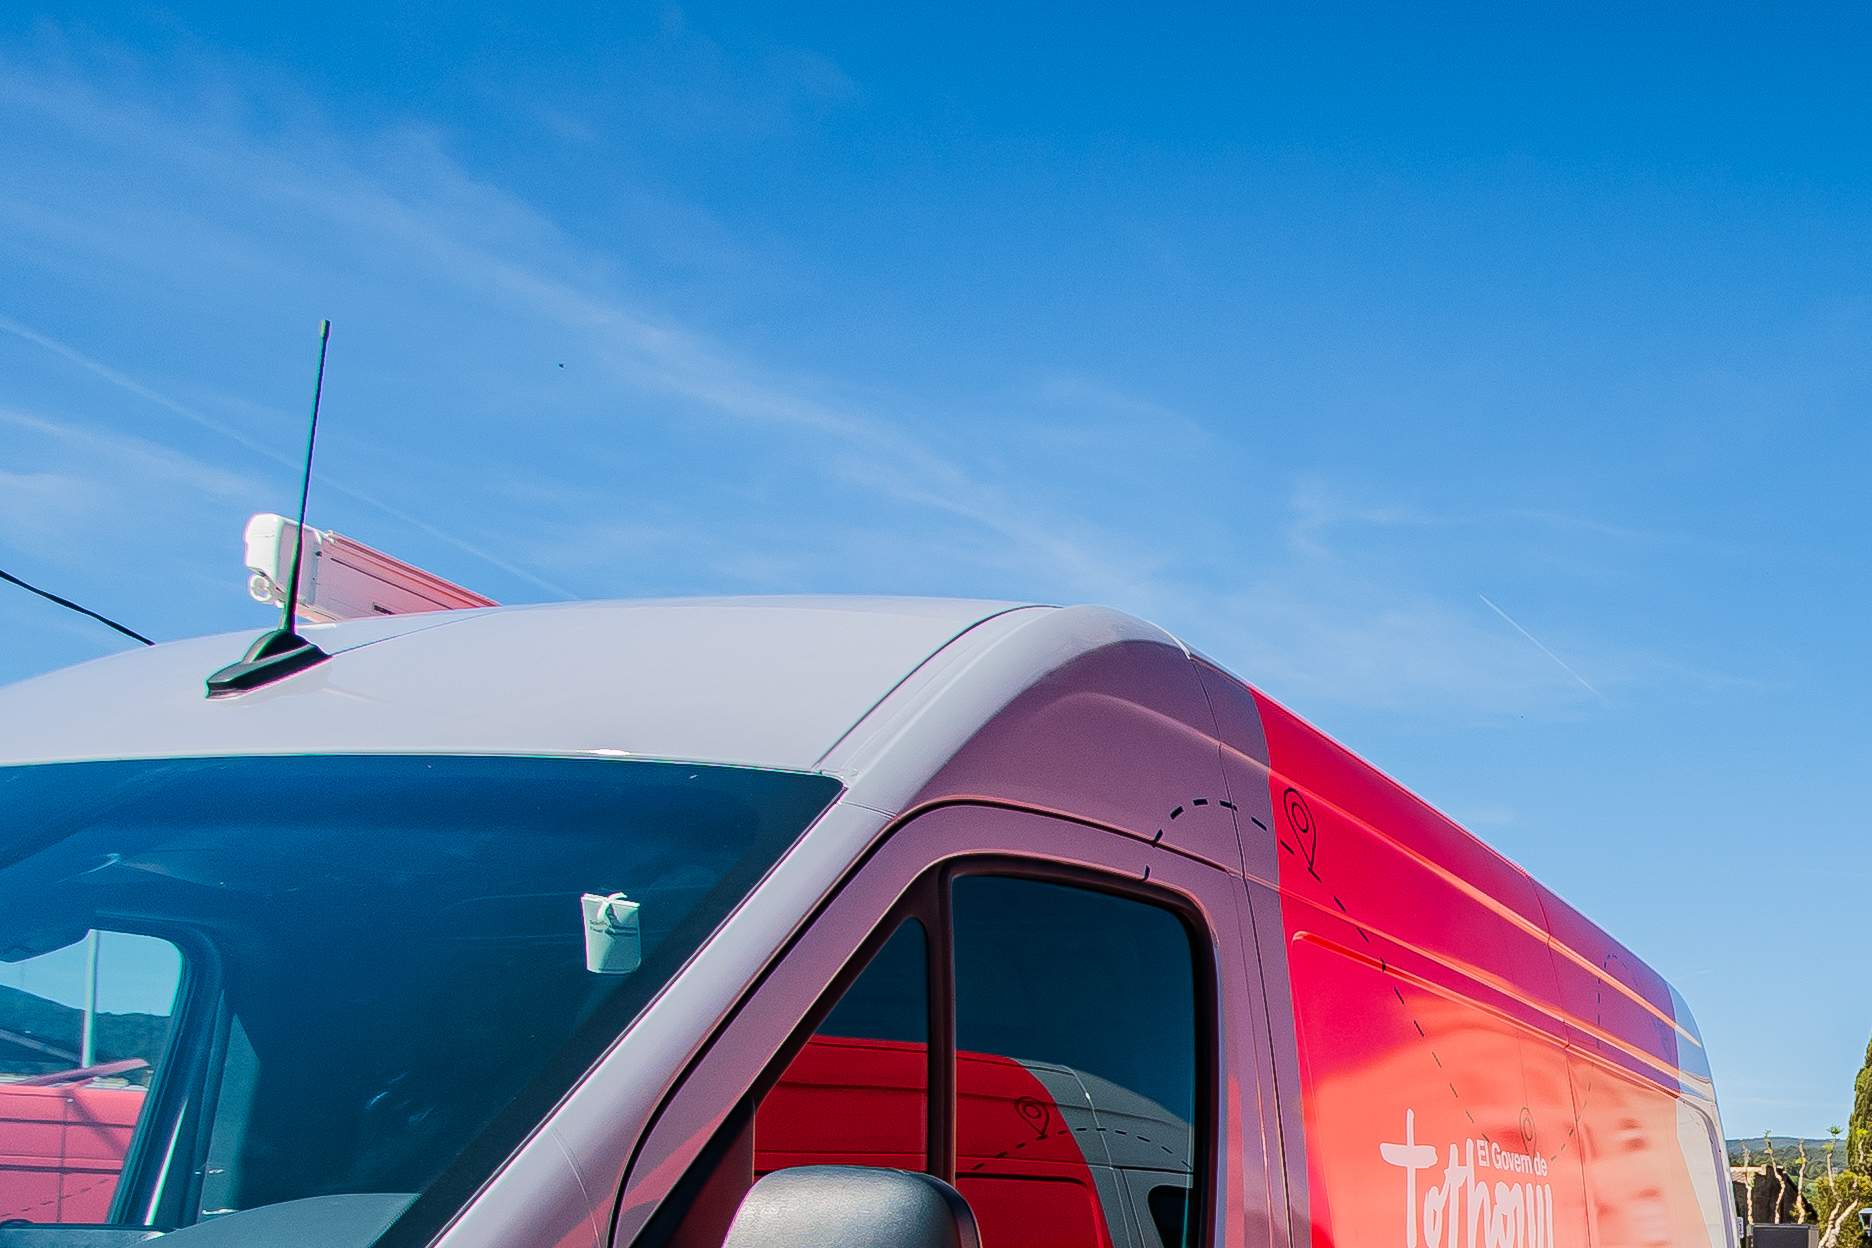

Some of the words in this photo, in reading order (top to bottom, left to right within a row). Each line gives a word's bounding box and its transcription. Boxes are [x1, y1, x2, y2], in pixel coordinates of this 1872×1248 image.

[1477, 1139, 1490, 1167] El
[1491, 1142, 1534, 1174] Govern
[1533, 1151, 1549, 1177] de
